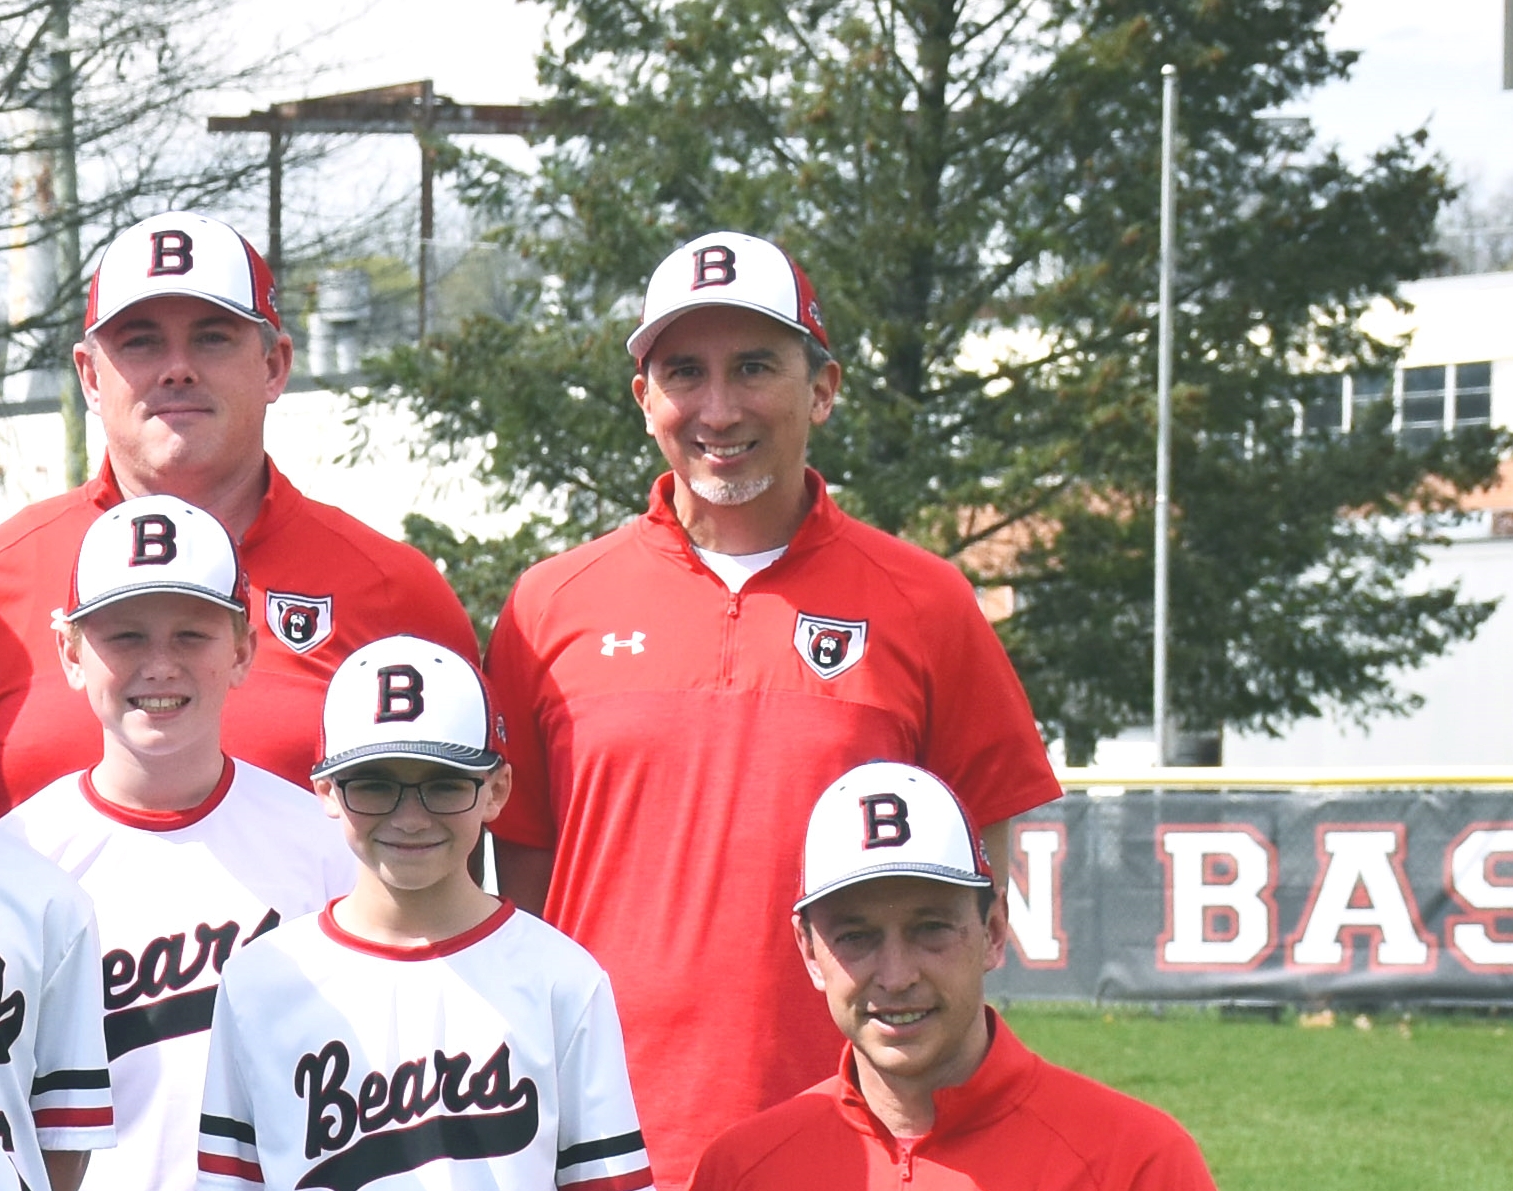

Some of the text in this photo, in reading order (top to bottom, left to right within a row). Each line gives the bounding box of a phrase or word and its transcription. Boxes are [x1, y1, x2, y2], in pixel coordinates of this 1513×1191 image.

[147, 229, 194, 278] B
[691, 245, 736, 291] B
[128, 513, 178, 568] B
[374, 664, 425, 724] B
[859, 792, 912, 851] B
[102, 907, 281, 1010] ear
[294, 1039, 539, 1160] Bears
